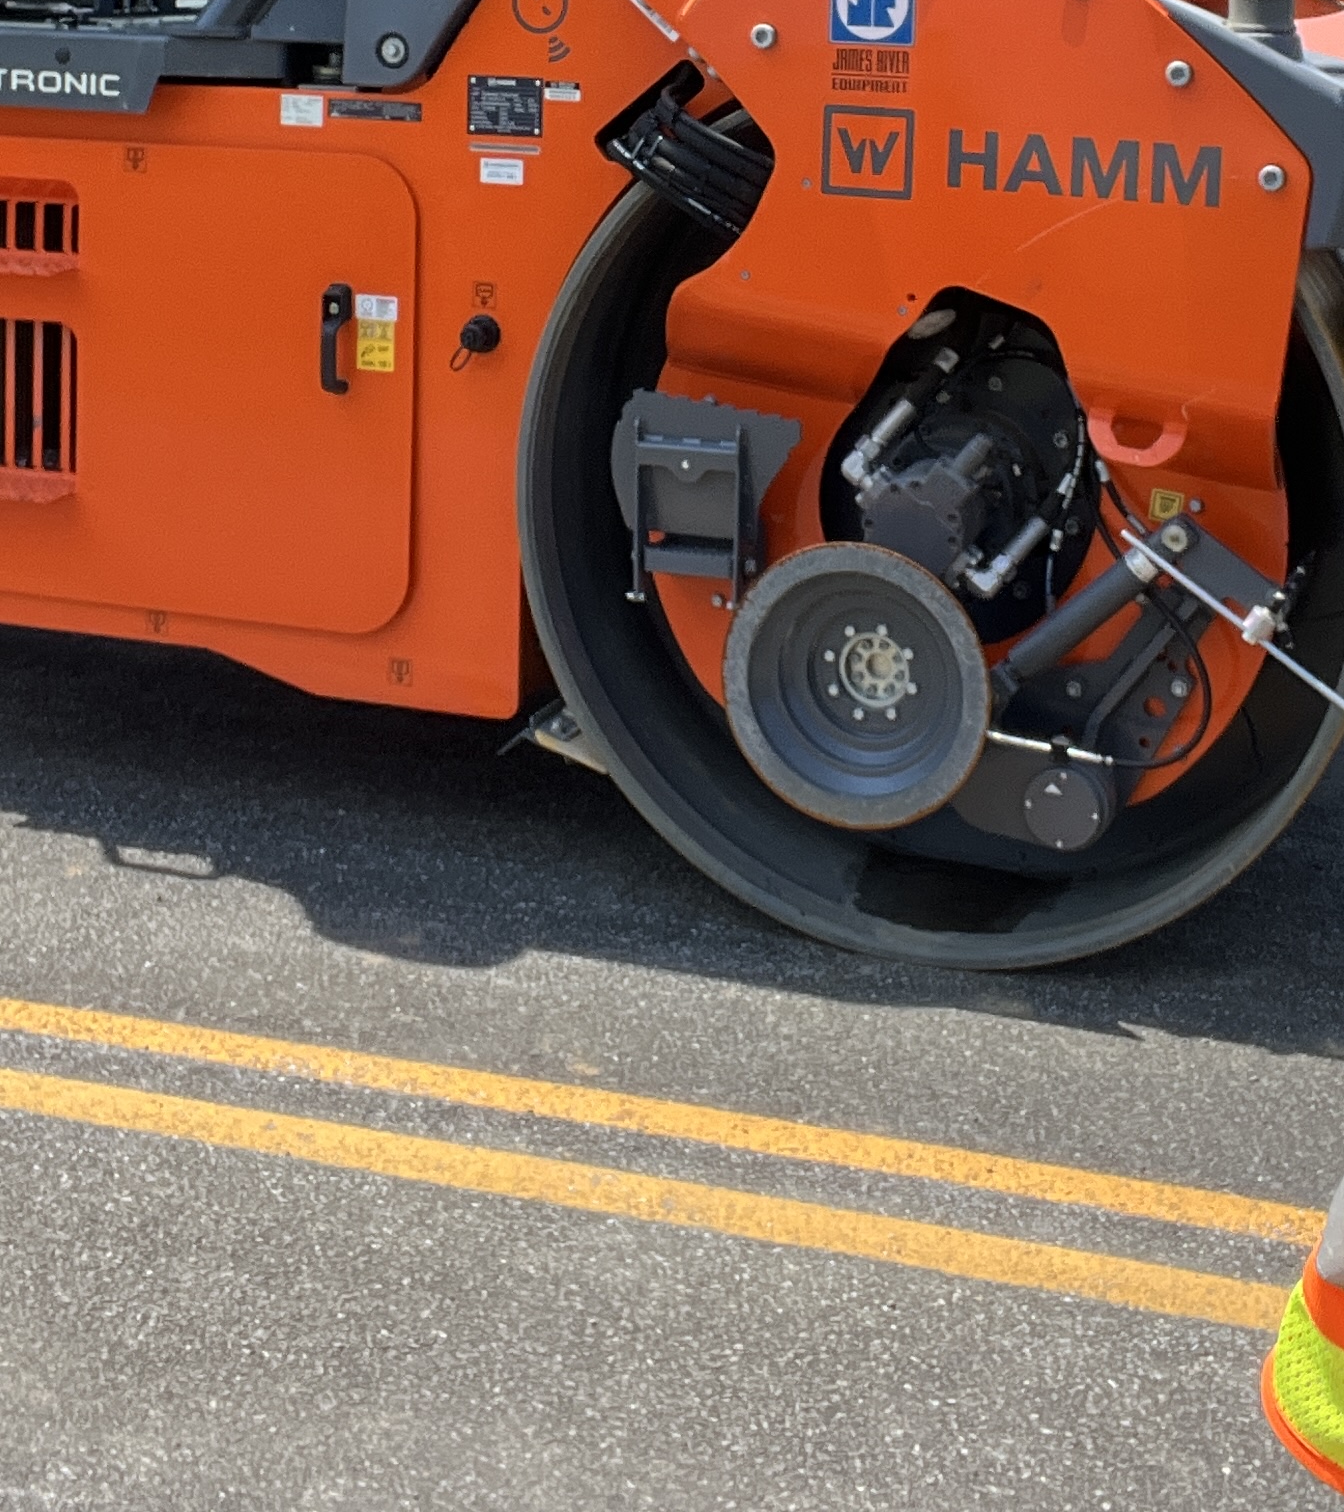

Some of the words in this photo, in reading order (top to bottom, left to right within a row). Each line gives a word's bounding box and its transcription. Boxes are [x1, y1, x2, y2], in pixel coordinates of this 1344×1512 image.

[832, 48, 873, 73] JAMES
[876, 50, 910, 75] RIVER
[831, 77, 908, 94] EQUIPMENT
[947, 128, 1223, 208] HAMM
